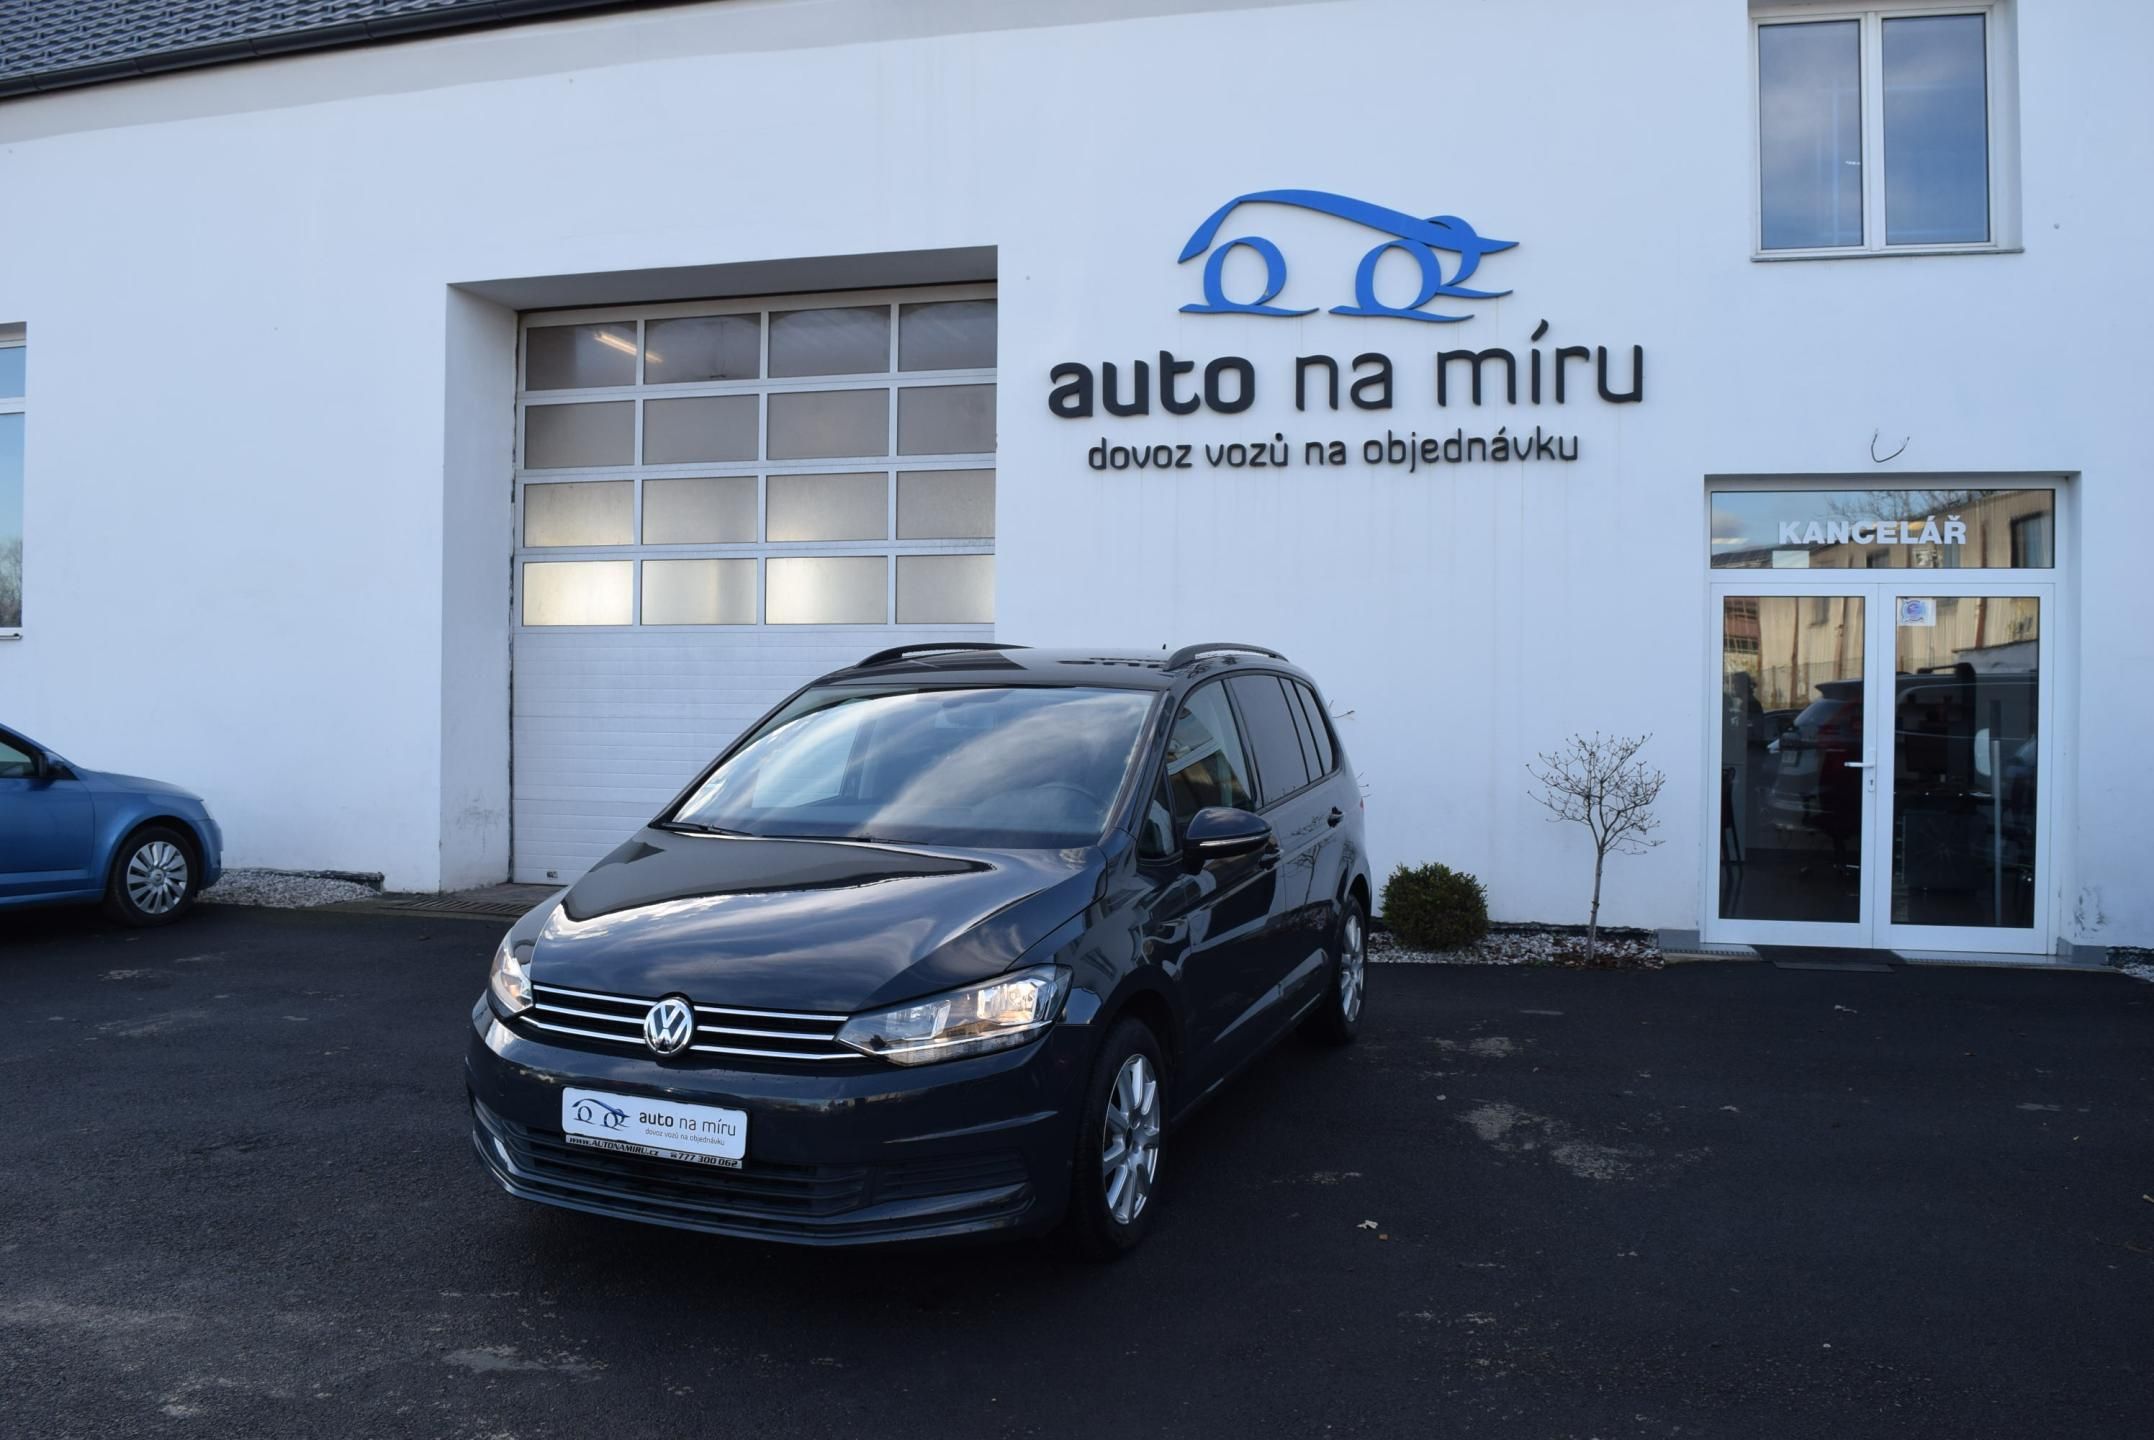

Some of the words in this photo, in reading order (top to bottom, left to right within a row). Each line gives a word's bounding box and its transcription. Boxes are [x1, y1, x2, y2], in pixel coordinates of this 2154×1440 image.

[1048, 349, 1256, 418] auto
[1295, 351, 1393, 412] na
[1436, 318, 1644, 407] míru
[1088, 437, 1193, 471] dovoz
[1205, 432, 1289, 468] vozů
[1304, 439, 1347, 466] na
[1363, 425, 1579, 473] objednávku
[1778, 515, 1967, 545] KANCELÁŘ
[639, 1111, 674, 1128] auto
[679, 1117, 697, 1131] na
[702, 1118, 737, 1137] míru
[645, 1127, 663, 1137] dovoz
[680, 1133, 689, 1141] na
[698, 1155, 717, 1165] 300
[718, 1159, 738, 1168] 062
